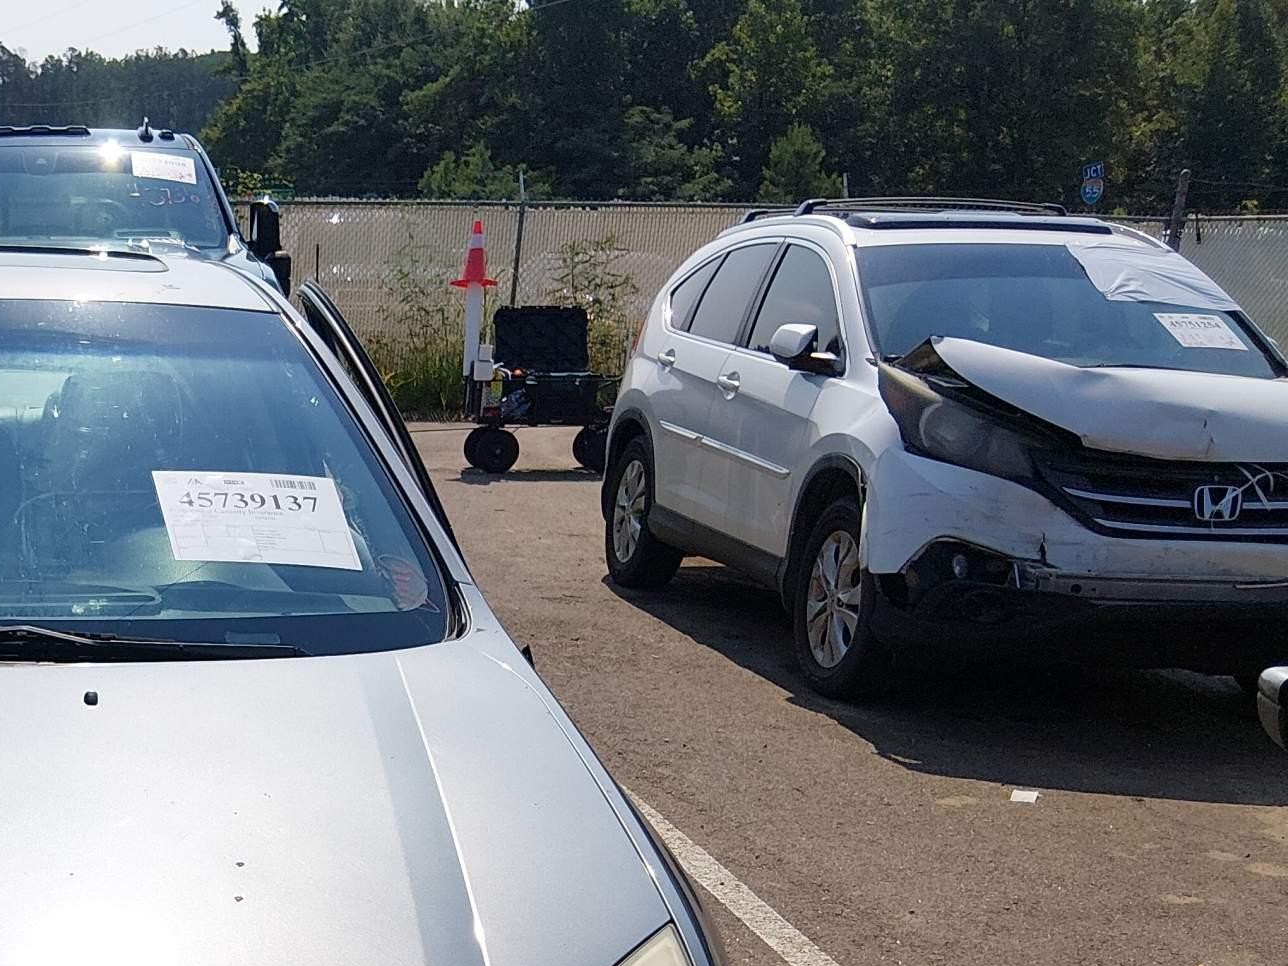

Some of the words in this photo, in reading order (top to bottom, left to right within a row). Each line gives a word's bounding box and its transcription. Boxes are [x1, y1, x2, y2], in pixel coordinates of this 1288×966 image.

[1085, 164, 1102, 179] JCT
[1085, 186, 1099, 198] 55
[178, 492, 318, 513] 45739137
